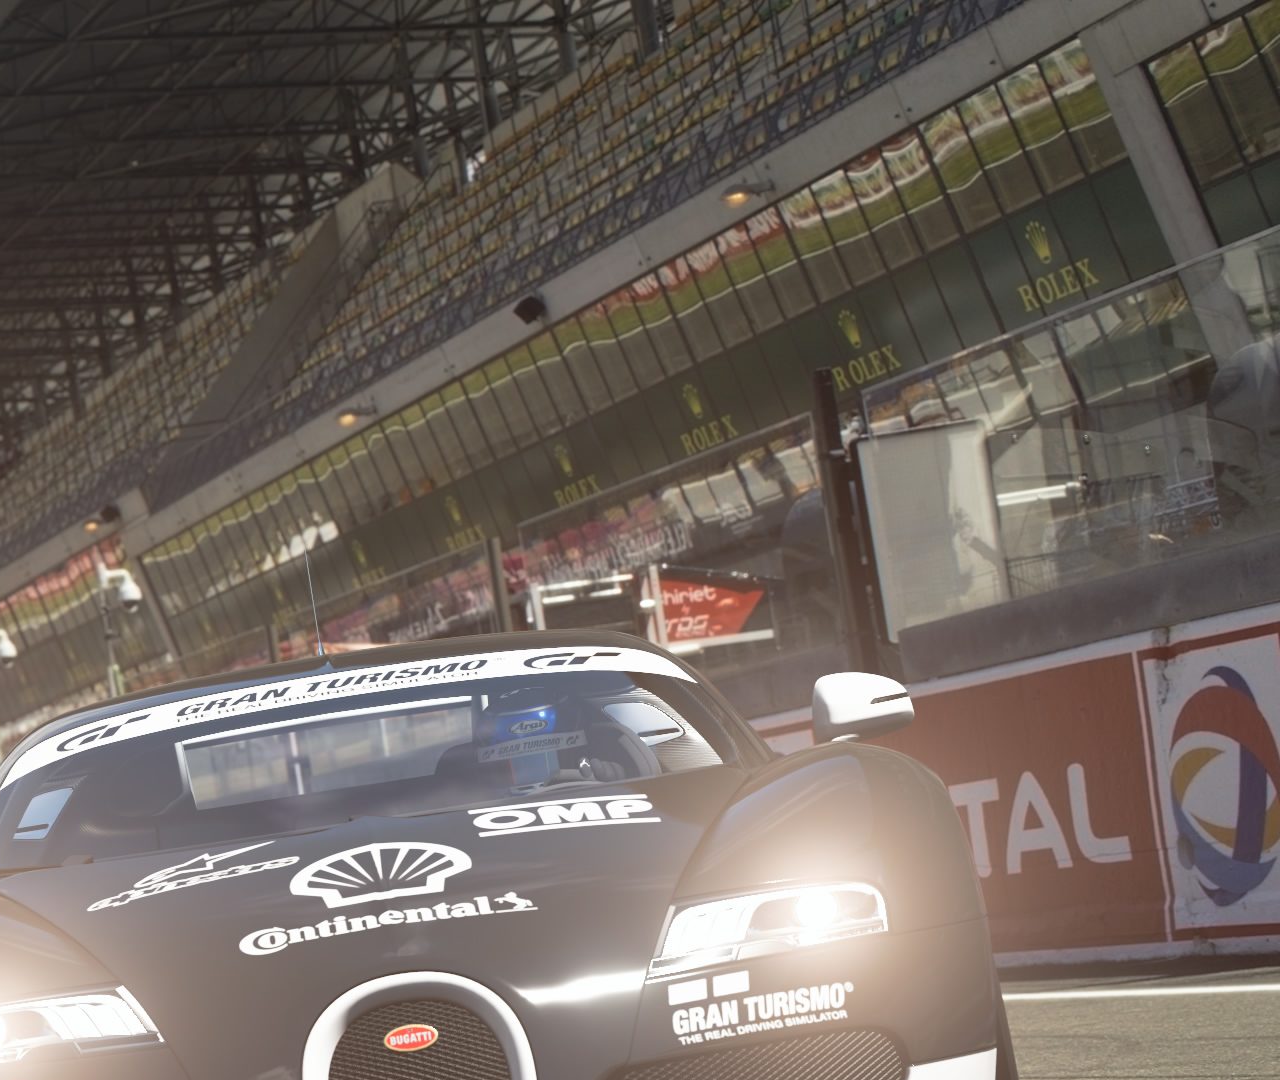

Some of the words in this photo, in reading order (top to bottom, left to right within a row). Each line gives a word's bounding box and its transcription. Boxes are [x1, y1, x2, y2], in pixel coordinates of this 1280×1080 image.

[1017, 258, 1100, 312] ROLEX
[831, 344, 902, 392] ROLEX
[680, 414, 739, 456] ROLEX
[554, 474, 603, 509] ROLEX
[661, 585, 717, 606] hiriet
[176, 686, 292, 717] GRAN
[307, 659, 488, 693] TURISMO
[473, 799, 653, 830] OMP
[948, 762, 1133, 879] TAL
[239, 896, 496, 956] Continental
[672, 999, 739, 1035] GRAN
[678, 1036, 703, 1046] THE
[704, 1028, 737, 1042] REAL
[737, 1019, 784, 1035] DRIVING
[785, 1009, 848, 1027] SIMULATOR
[390, 1031, 433, 1046] BUGATTI
